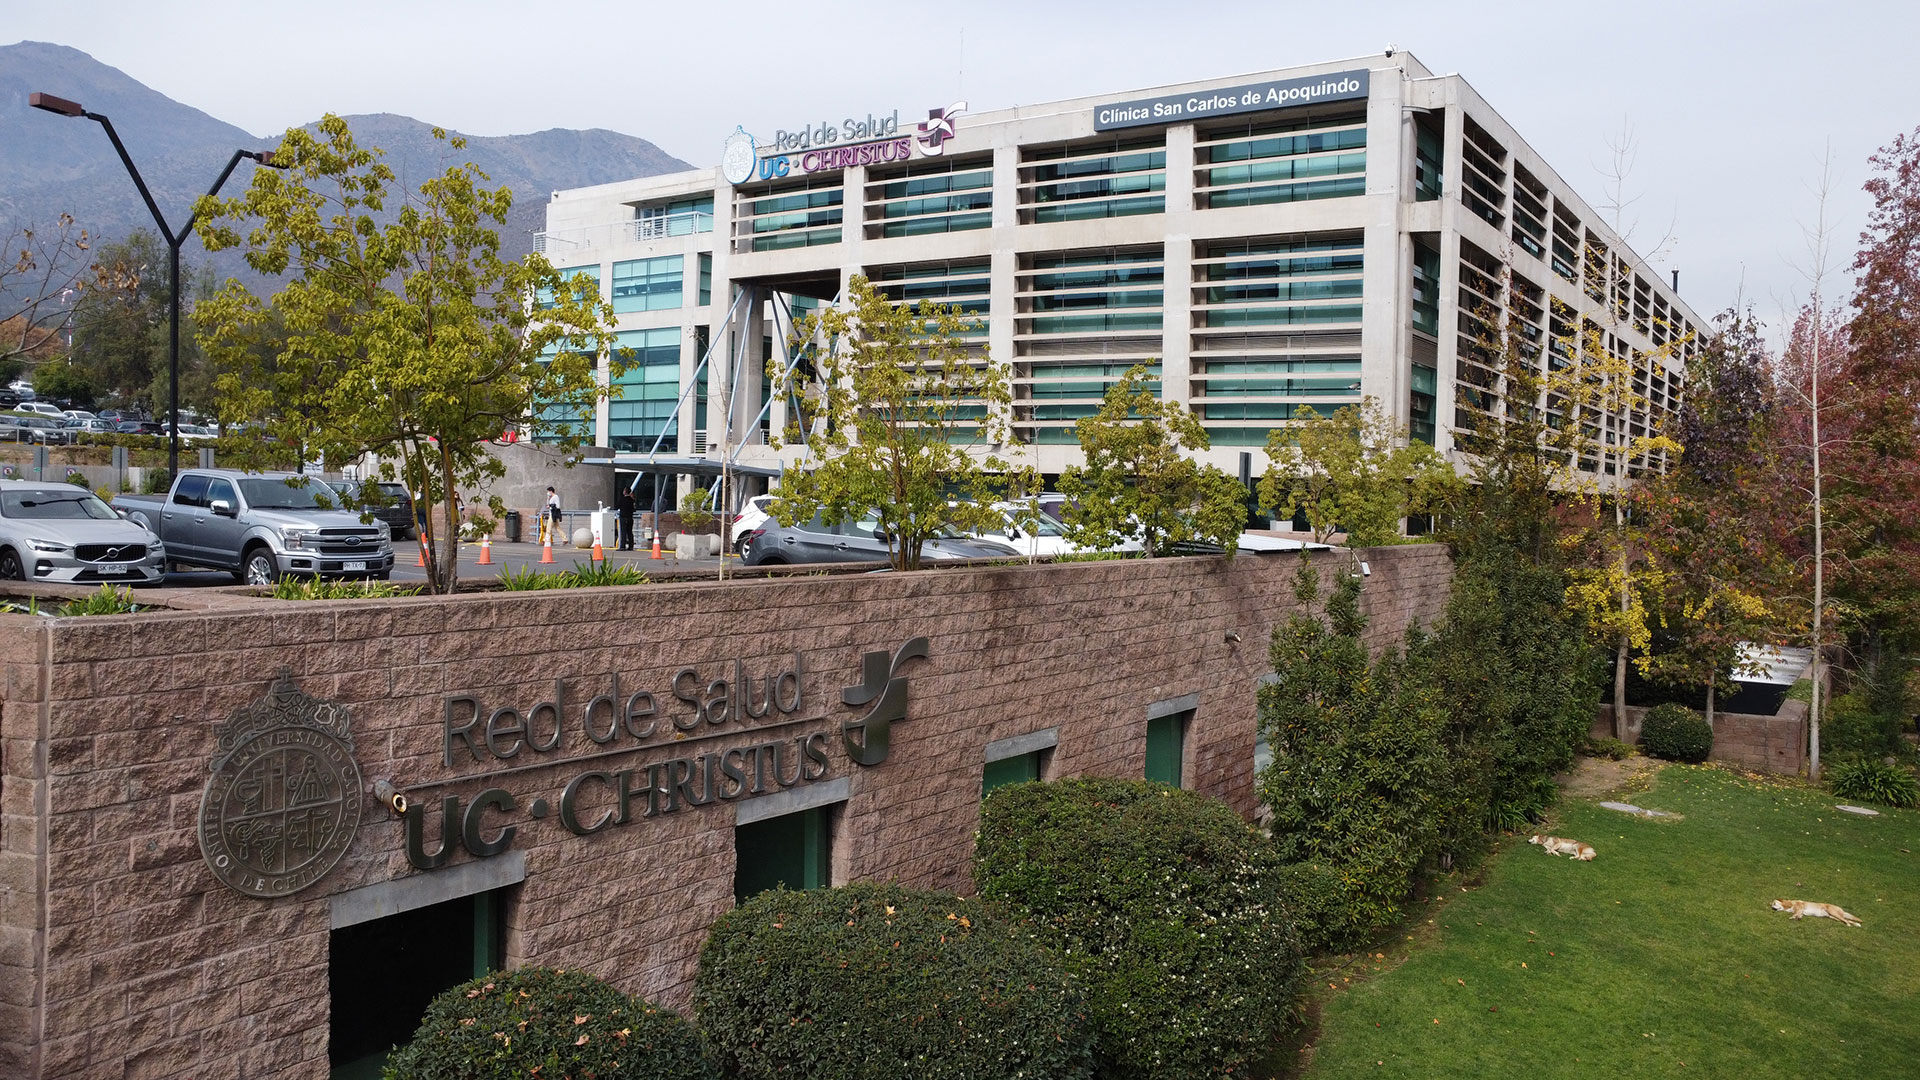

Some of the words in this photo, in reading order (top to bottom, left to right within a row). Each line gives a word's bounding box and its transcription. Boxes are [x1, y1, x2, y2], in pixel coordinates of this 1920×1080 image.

[1099, 106, 1149, 125] Clínica
[1153, 102, 1182, 117] San
[1186, 96, 1237, 113] Carlos
[1241, 91, 1262, 106] de
[1265, 78, 1360, 104] Apoquindo
[775, 124, 811, 151] Red
[813, 121, 838, 145] de
[842, 109, 898, 141] Salud
[758, 155, 791, 180] UC
[802, 138, 912, 173] CHRISTUS
[443, 677, 565, 768] Red
[584, 672, 658, 744] de
[670, 650, 803, 731] Salud
[230, 731, 344, 767] UNIVERSIDAD
[405, 788, 517, 870] UC
[559, 731, 831, 836] CHRISTUS
[240, 874, 266, 892] DE
[271, 857, 330, 891] CHILE
